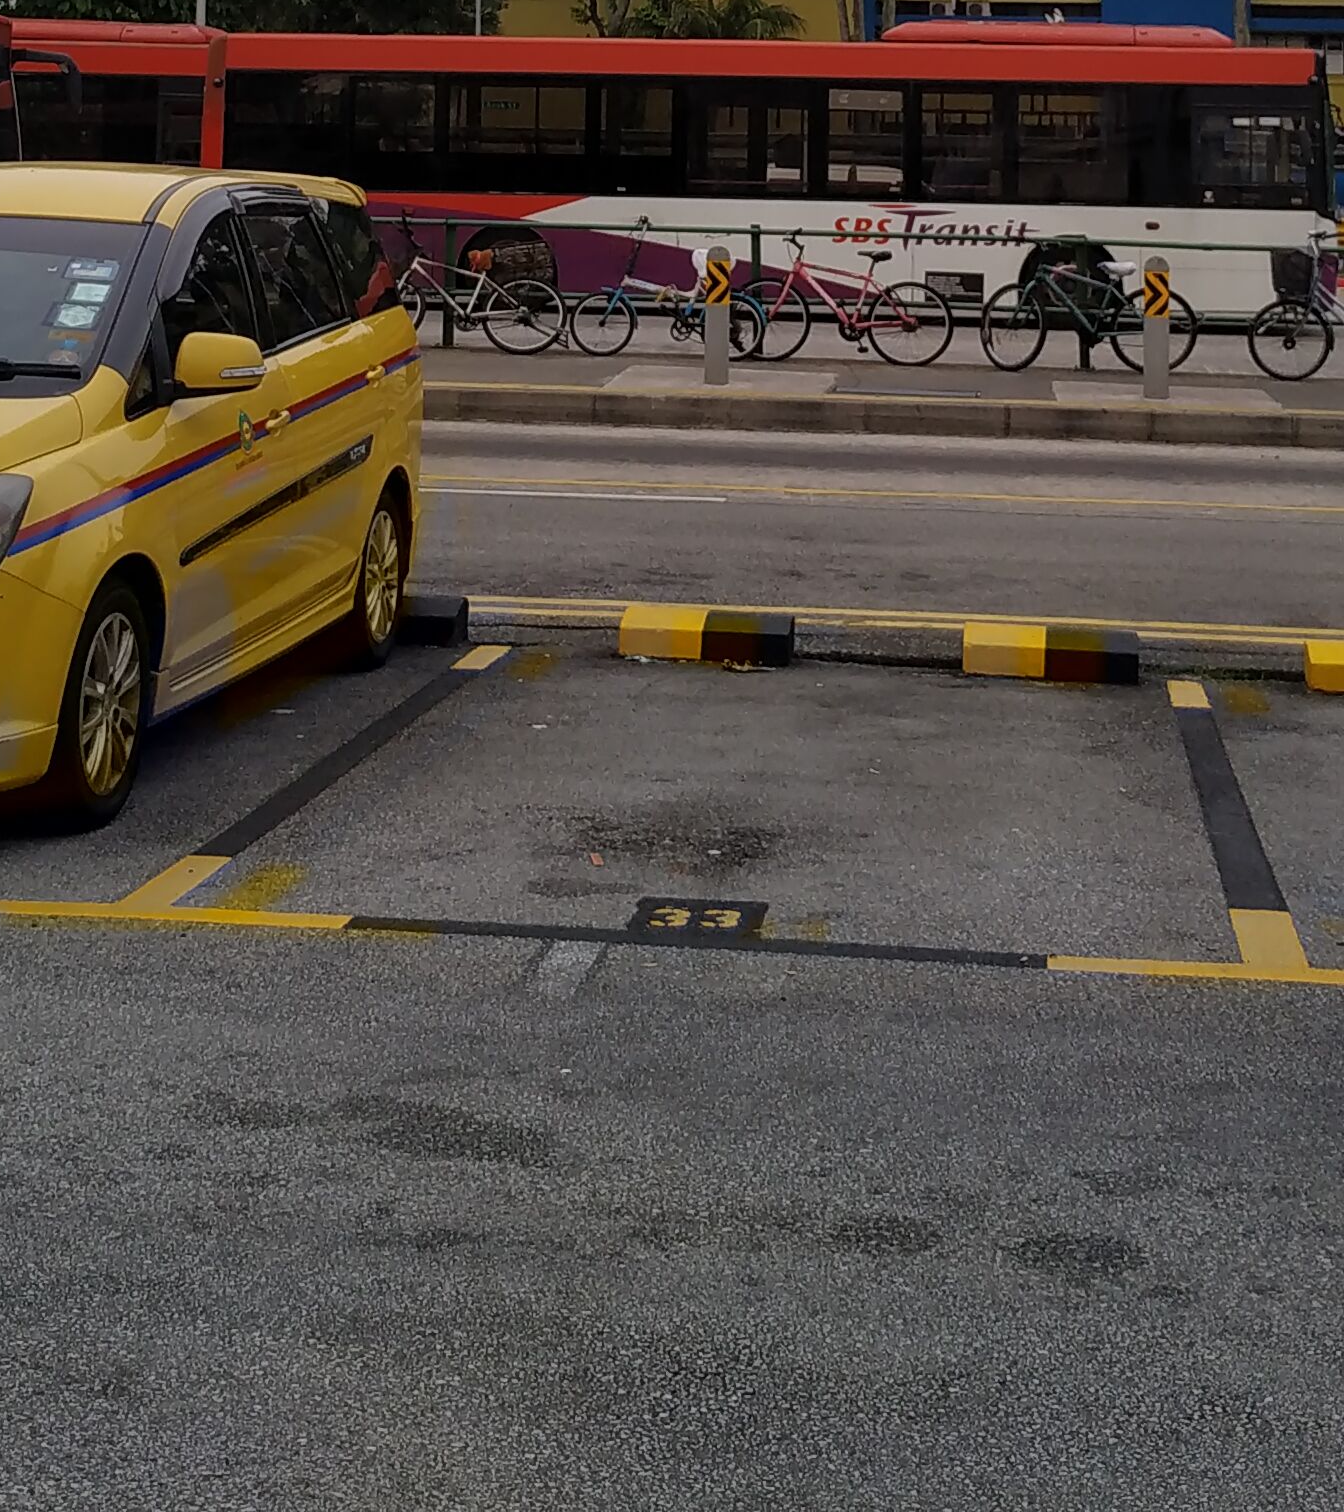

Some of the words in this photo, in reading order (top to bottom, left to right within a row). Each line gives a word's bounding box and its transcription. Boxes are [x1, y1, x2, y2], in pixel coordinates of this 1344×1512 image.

[832, 217, 893, 245] SBS
[884, 210, 1041, 251] Transit
[647, 905, 743, 929] 33
